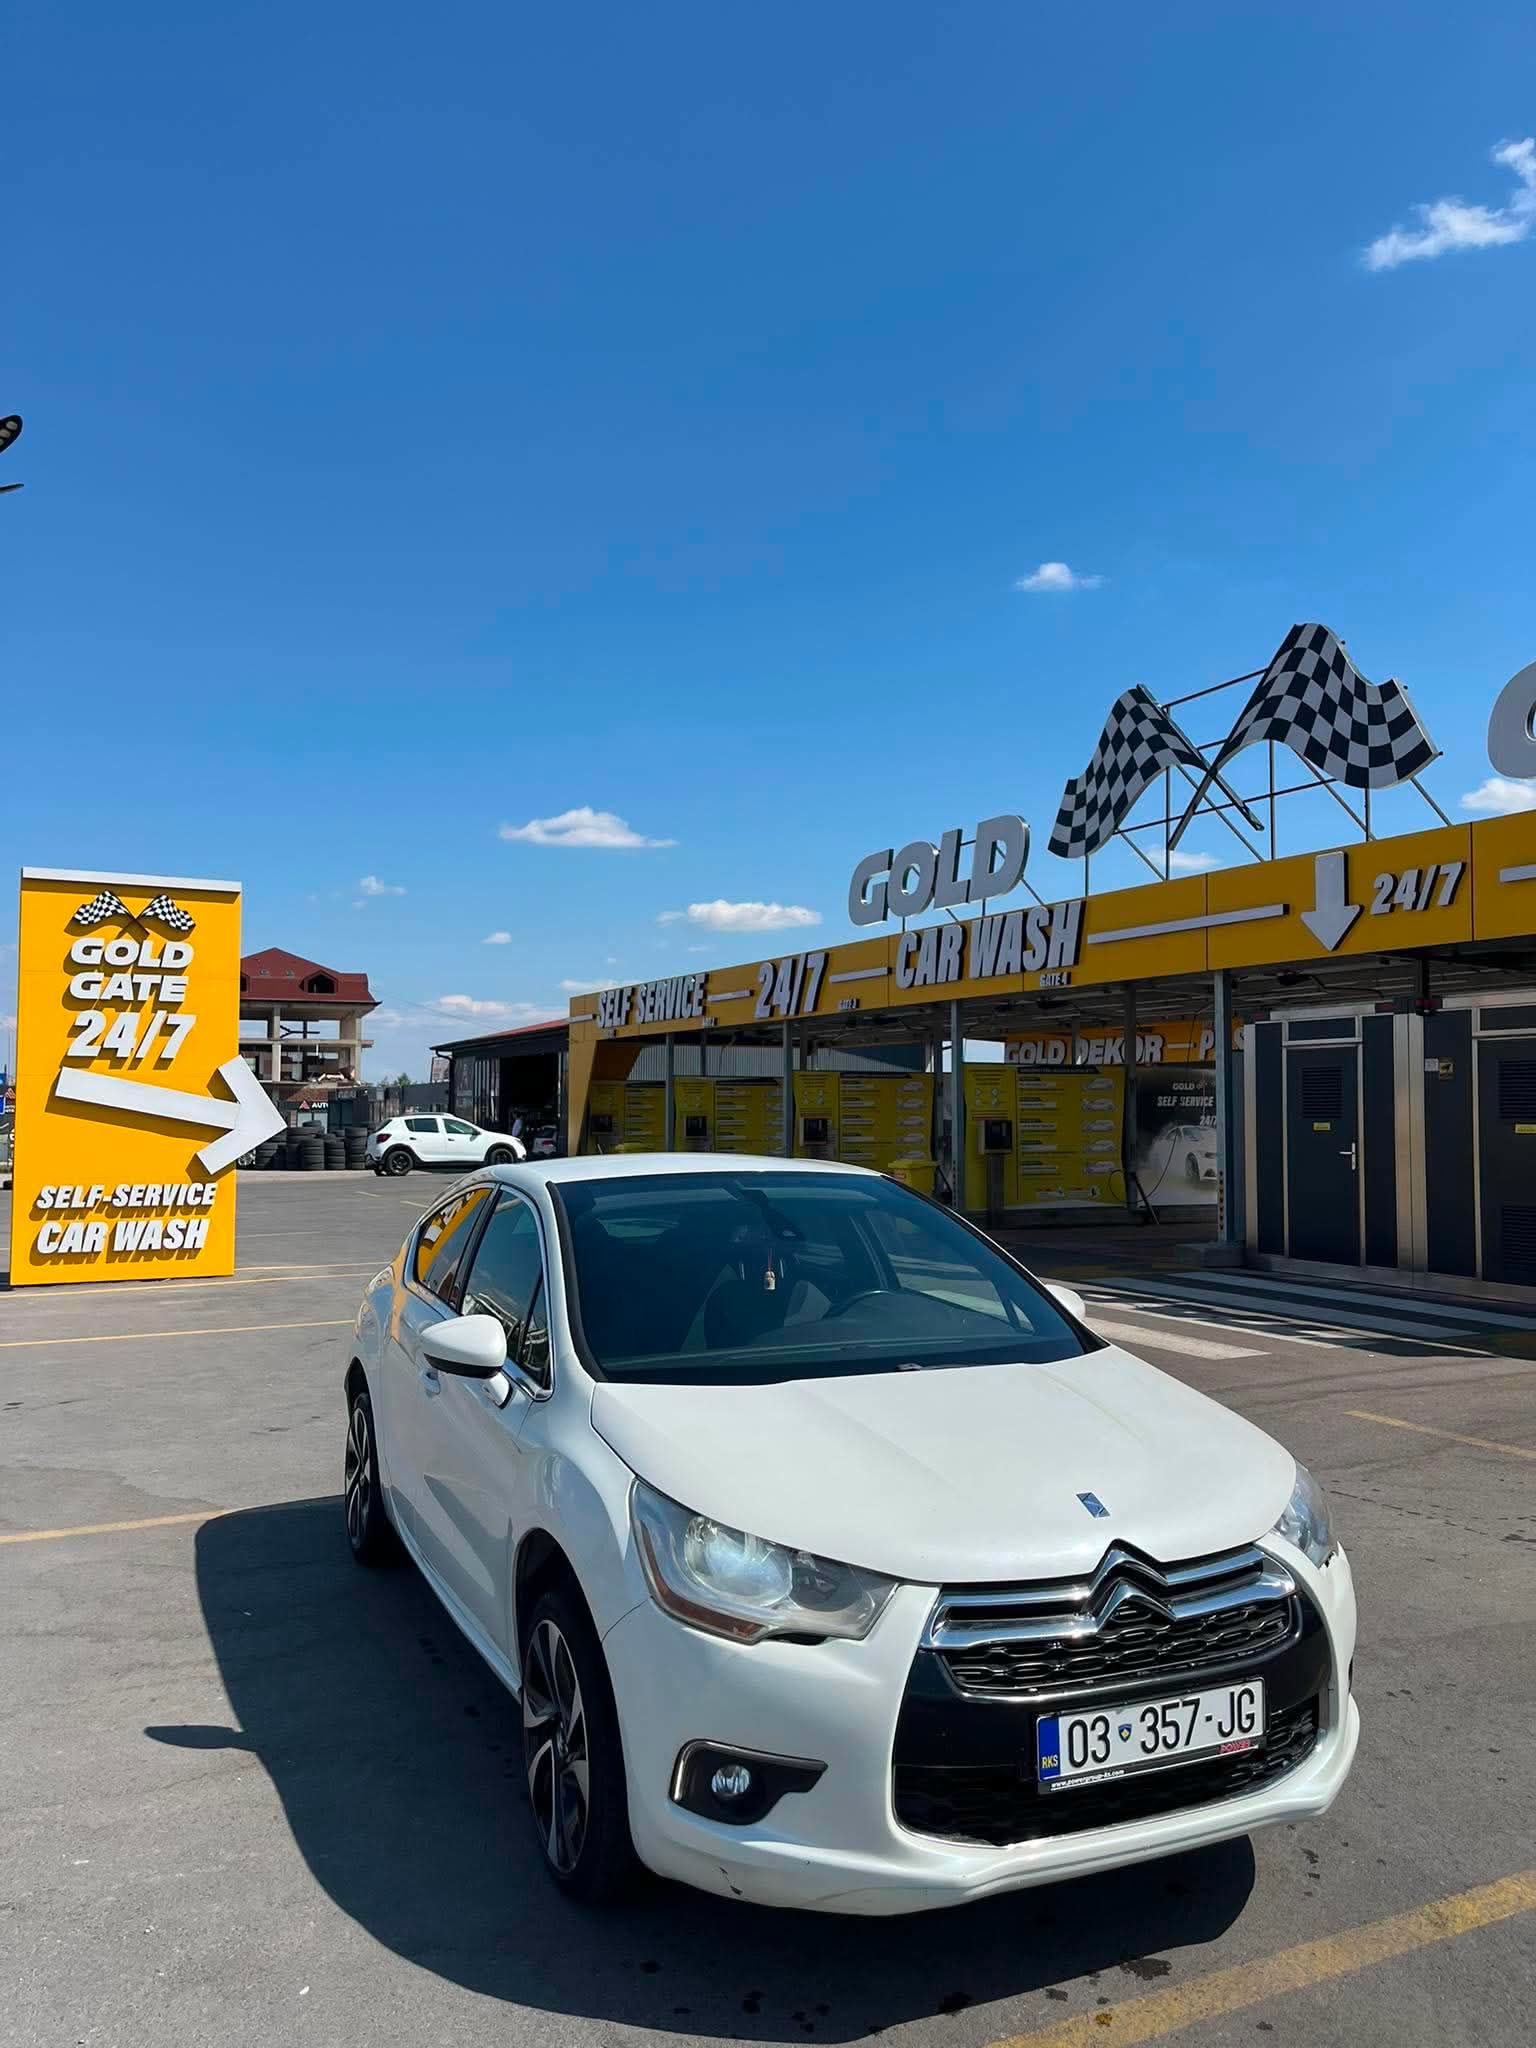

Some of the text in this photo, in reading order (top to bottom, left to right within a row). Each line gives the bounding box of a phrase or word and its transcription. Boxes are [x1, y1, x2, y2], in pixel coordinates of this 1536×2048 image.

[848, 814, 1030, 926] GOLD
[1370, 862, 1463, 915] 24/7
[70, 937, 195, 969] GOLD
[597, 901, 1083, 1028] SELF SERVICE 24/7 CAR WASH
[69, 972, 189, 1002] GATE
[67, 1010, 197, 1059] 24/7
[1005, 1035, 1163, 1065] GOLD DEKOR
[1157, 1096, 1214, 1107] SELF SERVICE
[36, 1182, 218, 1209] SELF-SERVICE
[37, 1219, 210, 1254] CAR WASH
[1067, 1715, 1110, 1768] 03
[1041, 1755, 1058, 1769] RKS
